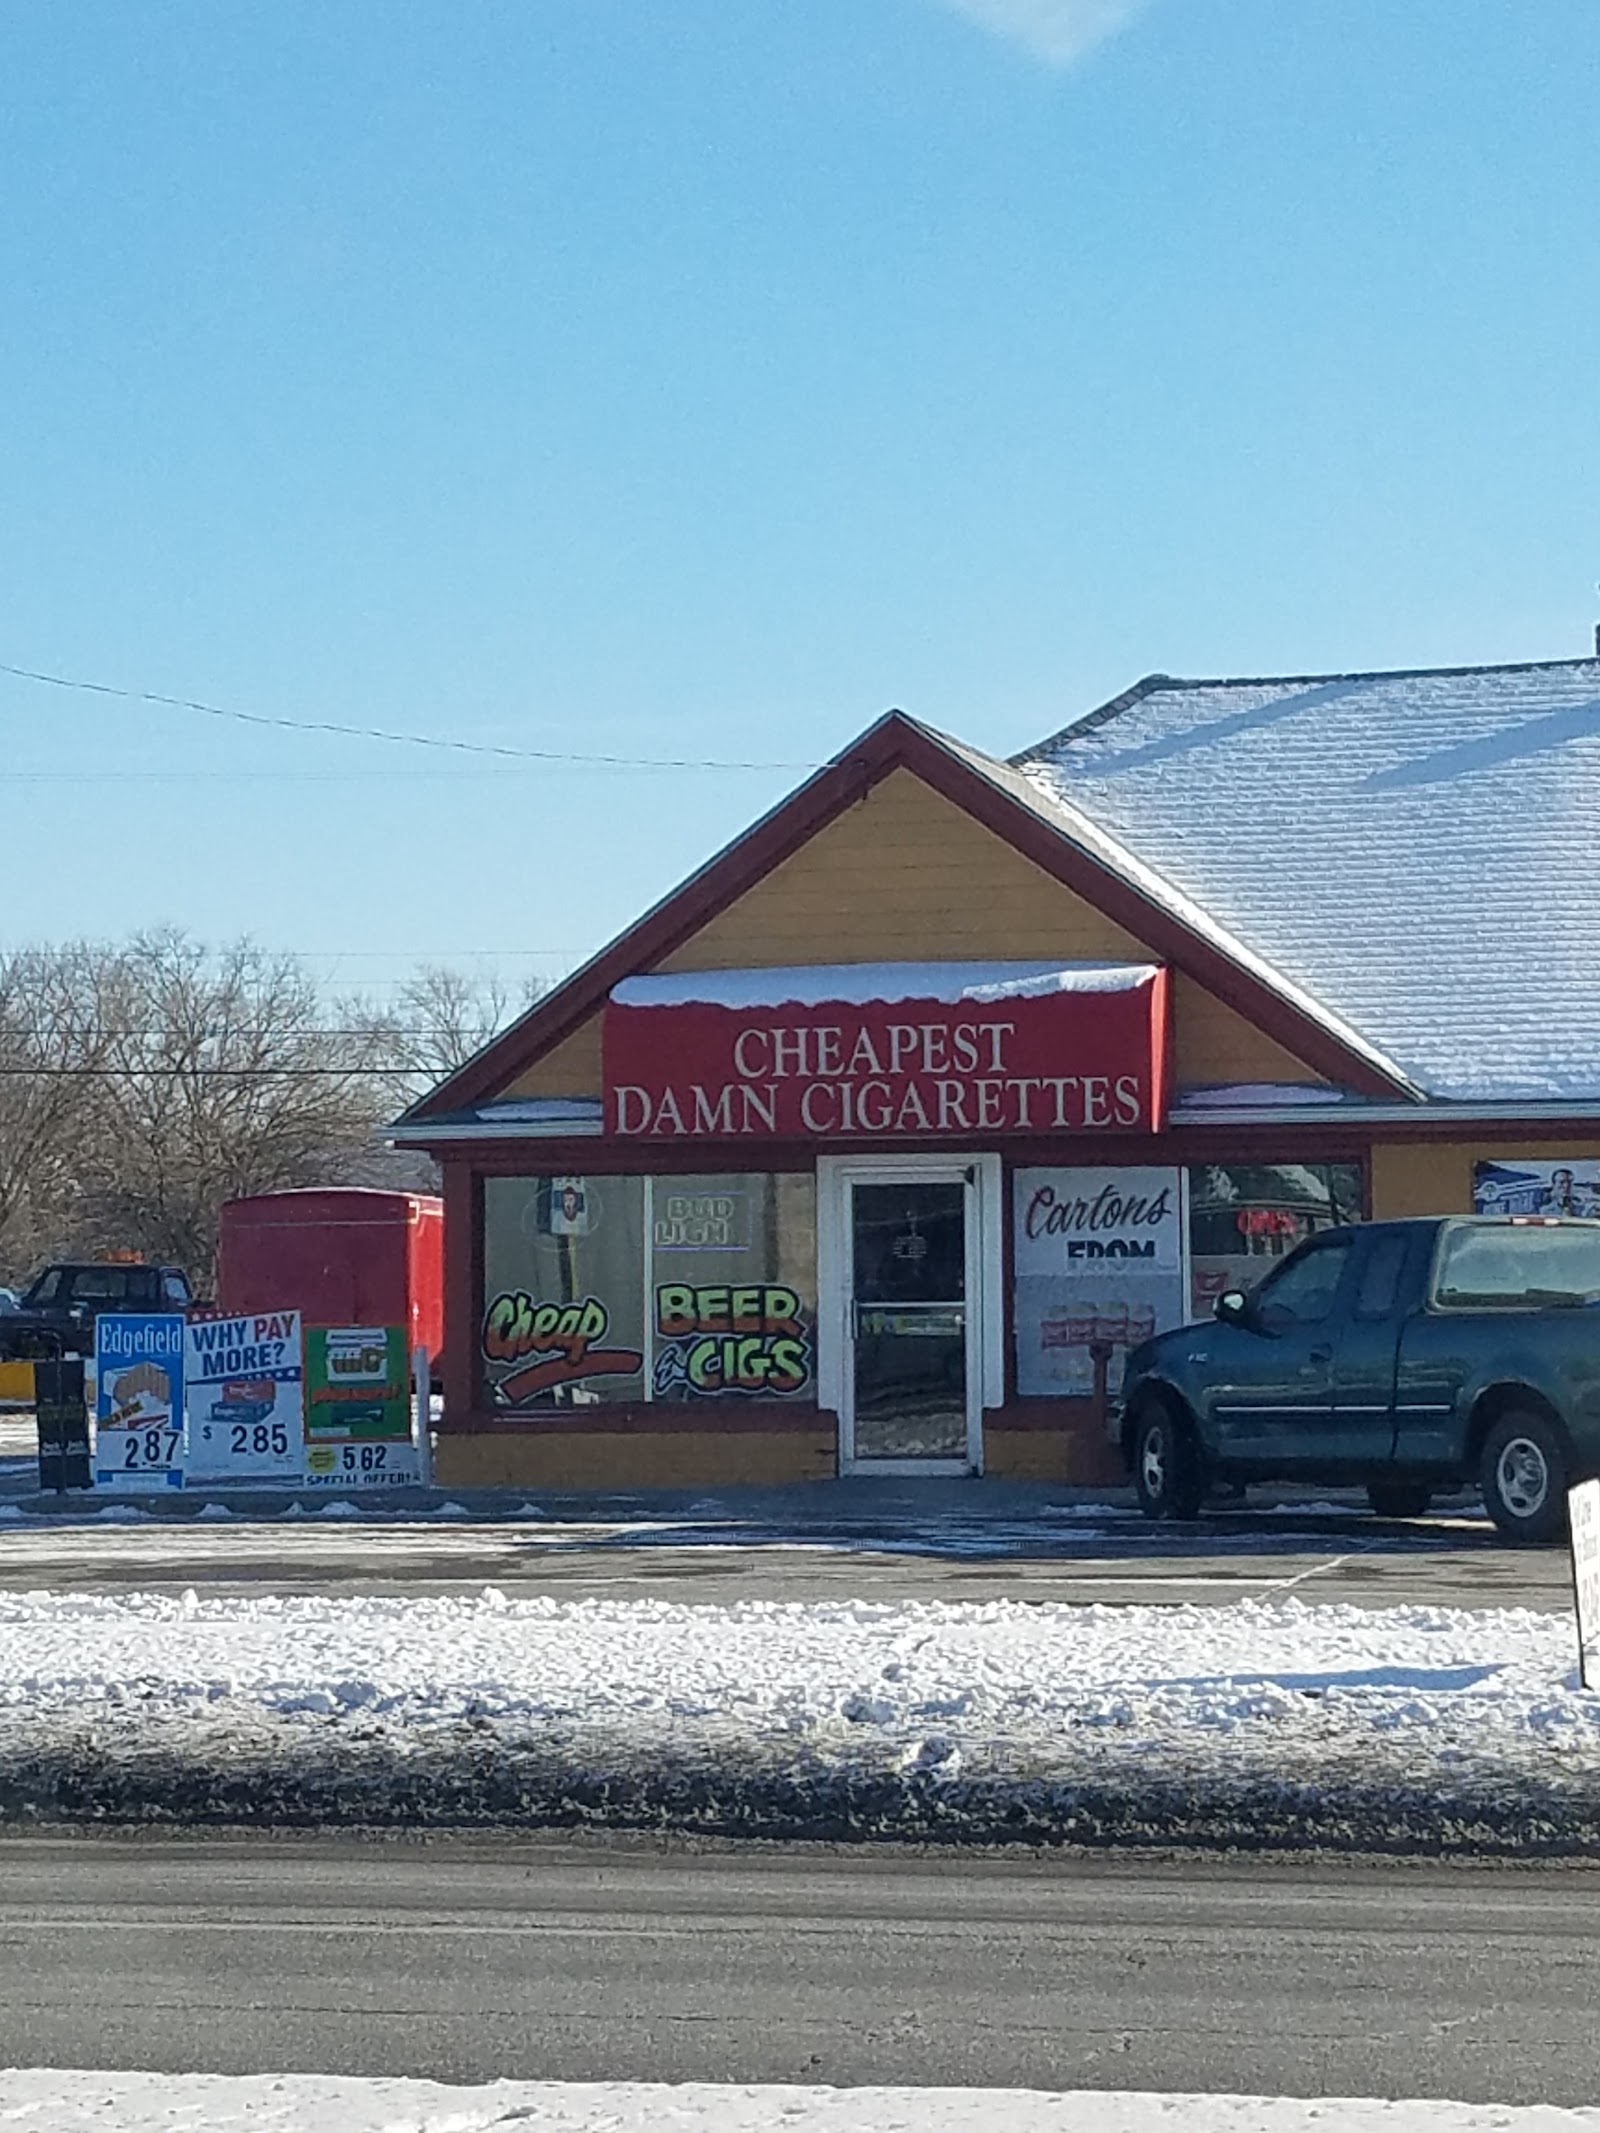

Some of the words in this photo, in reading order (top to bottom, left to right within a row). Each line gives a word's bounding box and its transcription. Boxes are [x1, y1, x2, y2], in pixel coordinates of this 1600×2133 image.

[733, 1022, 1015, 1078] CHEAPEST
[613, 1084, 778, 1136] DAMN
[801, 1074, 1140, 1133] CIGARETTES
[655, 1220, 741, 1245] LIGH
[667, 1197, 734, 1220] BUD
[1026, 1184, 1172, 1240] Cartons
[192, 1320, 247, 1352] WHY
[254, 1313, 295, 1343] PAY
[482, 1290, 608, 1366] Cheap
[656, 1283, 807, 1337] BEER
[100, 1324, 182, 1357] Edgefield
[202, 1342, 286, 1377] MORE?
[687, 1336, 811, 1394] CIGS
